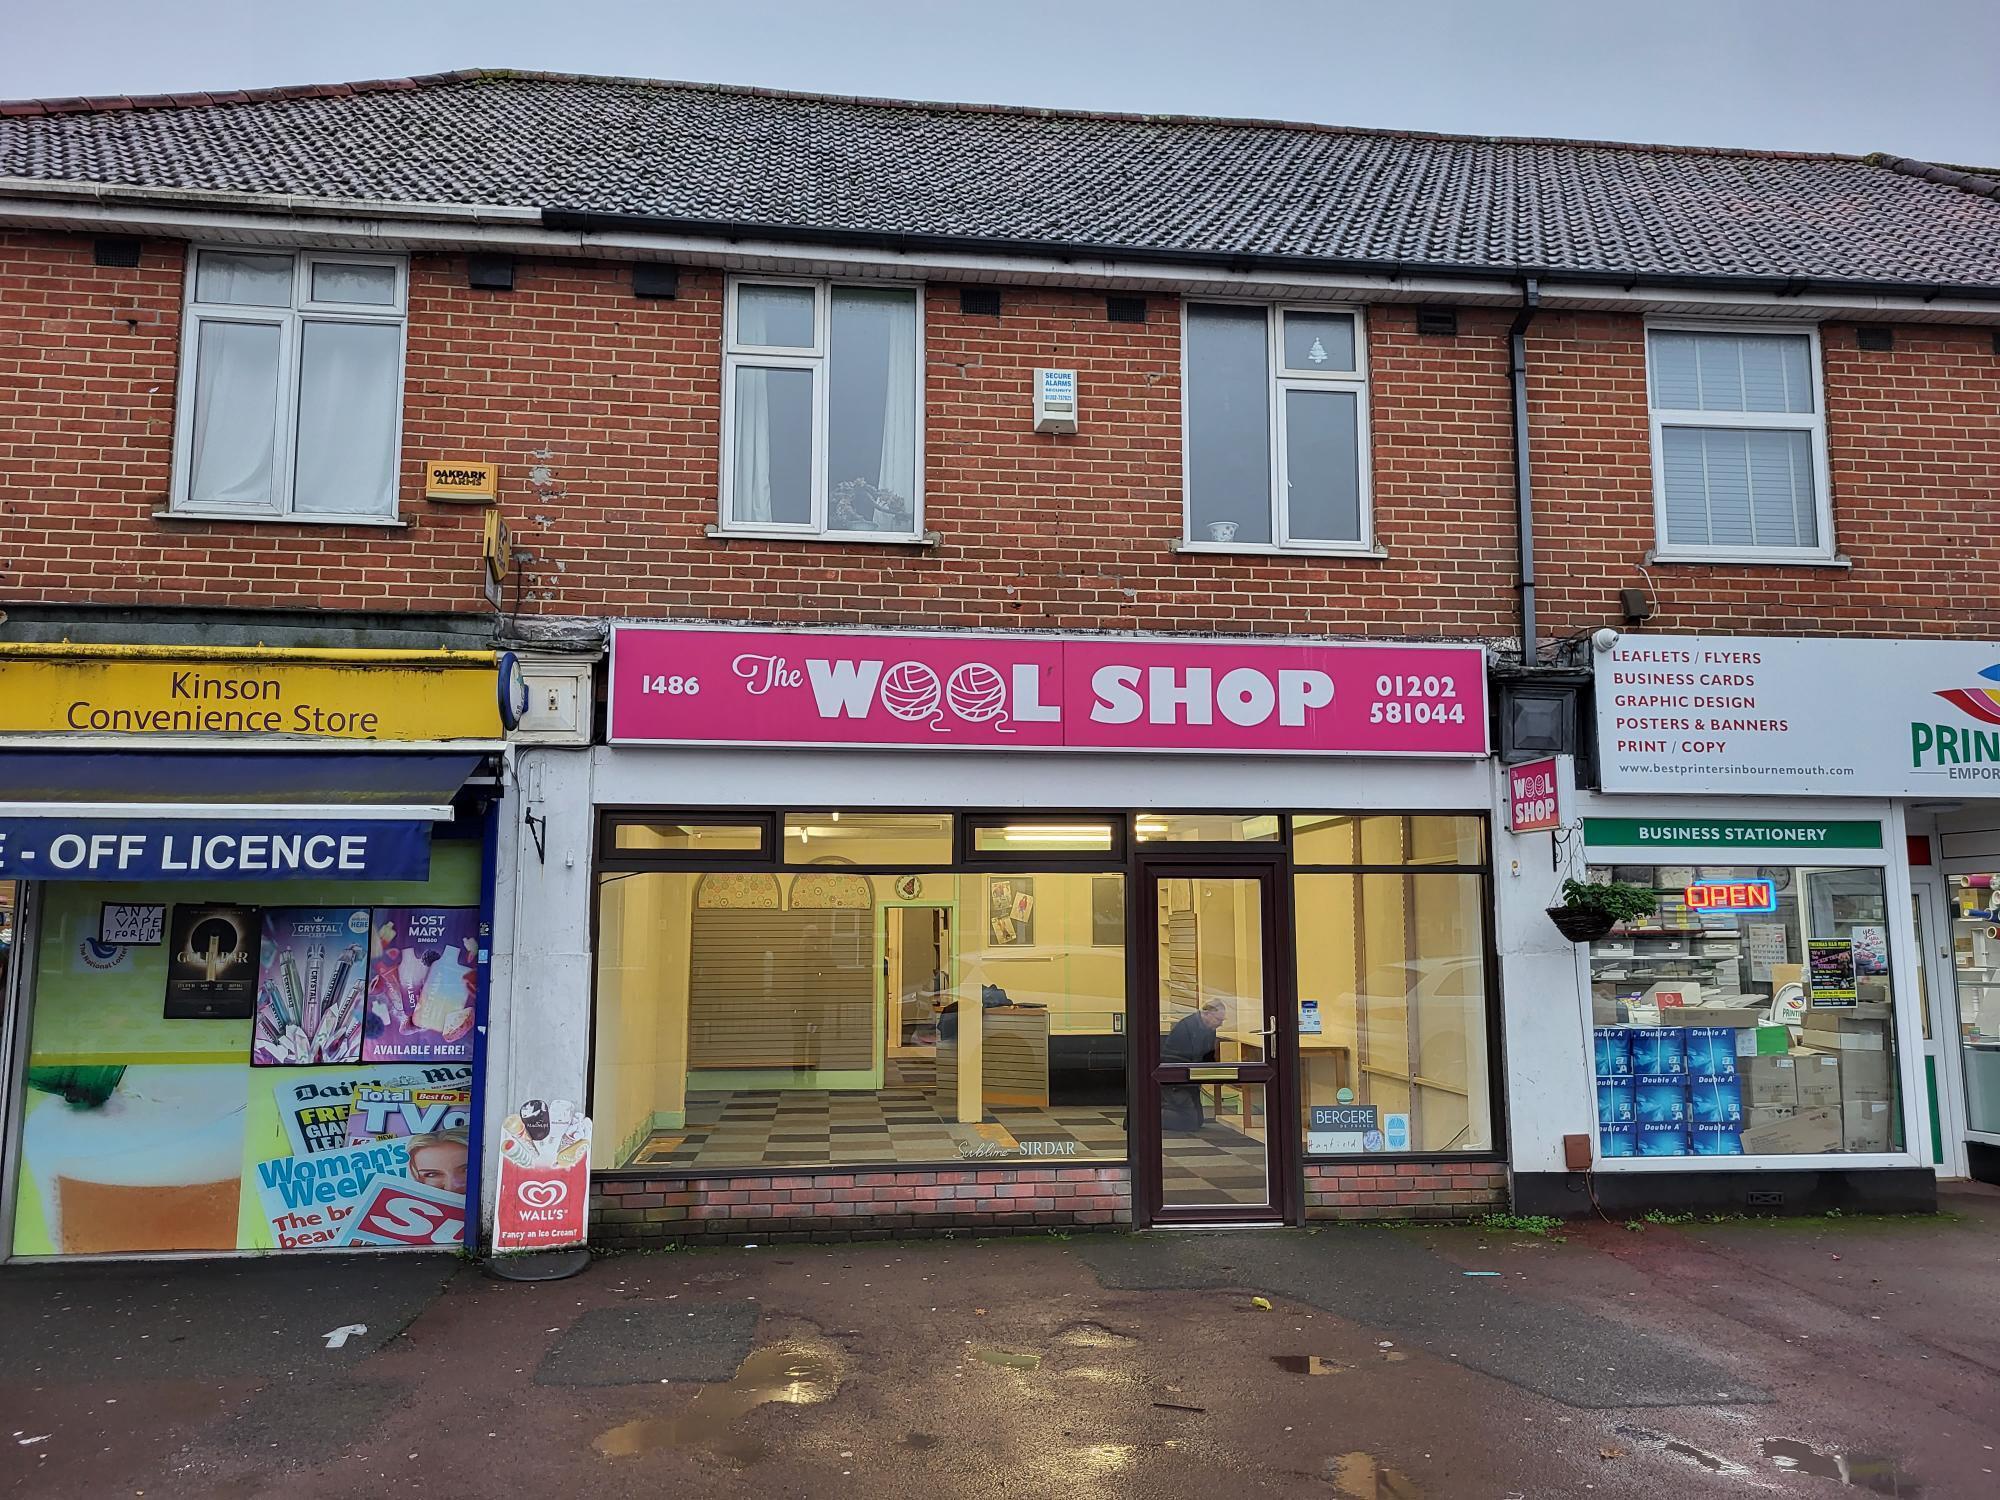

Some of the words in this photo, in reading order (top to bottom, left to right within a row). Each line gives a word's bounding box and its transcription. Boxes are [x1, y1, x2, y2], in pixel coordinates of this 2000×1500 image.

[1045, 372, 1072, 380] SECURE
[433, 469, 487, 480] OAKPARK
[436, 476, 482, 486] ALARMS
[1612, 650, 1691, 664] LEAFLETS
[1704, 652, 1762, 665] FLYERS
[172, 671, 281, 700] Kinson
[642, 674, 700, 696] 1486
[1376, 674, 1457, 698] 01202
[1614, 672, 1695, 686] BUSINESS
[1700, 674, 1755, 687] CARDS
[731, 653, 803, 696] The
[806, 659, 1061, 733] WOOL
[1090, 665, 1335, 727] SHOP
[1614, 695, 1689, 708] GRAPHIC
[1694, 696, 1756, 709] DESIGN
[67, 701, 282, 731] Convenience
[293, 704, 379, 732] Store
[1369, 702, 1466, 725] 581044
[1616, 717, 1690, 731] POSTERS
[1694, 718, 1706, 731] &
[1710, 719, 1789, 732] BANNERS
[1617, 740, 1667, 753] PRINT
[1681, 741, 1727, 754] COPY
[1911, 722, 2000, 768] PRIN
[1619, 762, 1855, 778] www.bestprintersinbournemouth.com
[1513, 772, 1554, 799] WOOL
[1515, 798, 1555, 824] SHOP
[1639, 826, 1721, 840] BUSINESS
[1725, 827, 1828, 841] STATIONERY
[49, 834, 147, 870] OFF
[161, 834, 368, 870] LICENCE
[1685, 884, 1769, 907] OPEN
[115, 905, 156, 919] ANY
[115, 917, 162, 929] VAPE
[351, 921, 369, 929] HERE
[411, 915, 446, 926] LOST
[105, 929, 113, 942] 2
[114, 930, 138, 940] FOR
[297, 924, 337, 933] CRYSTAL
[408, 926, 446, 937] MARY
[83, 955, 113, 970] National
[112, 946, 128, 969] Lotter
[309, 970, 319, 1004] CRYSTAL
[373, 1045, 431, 1055] AVAILABLE
[433, 1045, 465, 1055] HERE!
[1642, 1076, 1670, 1084] Double
[358, 1088, 411, 1102] Total
[419, 1093, 439, 1101] Best
[440, 1092, 454, 1101] for
[300, 1105, 350, 1125] FRE
[1316, 1110, 1374, 1124] BERGERE
[952, 1140, 1009, 1159] Sublime
[1019, 1141, 1076, 1156] SIRDAR
[258, 1143, 411, 1189] Woman's
[278, 1167, 407, 1210] Week
[272, 1212, 323, 1232] The
[519, 1209, 564, 1221] WALL'S
[502, 1231, 525, 1241] Fancy
[527, 1230, 537, 1238] an
